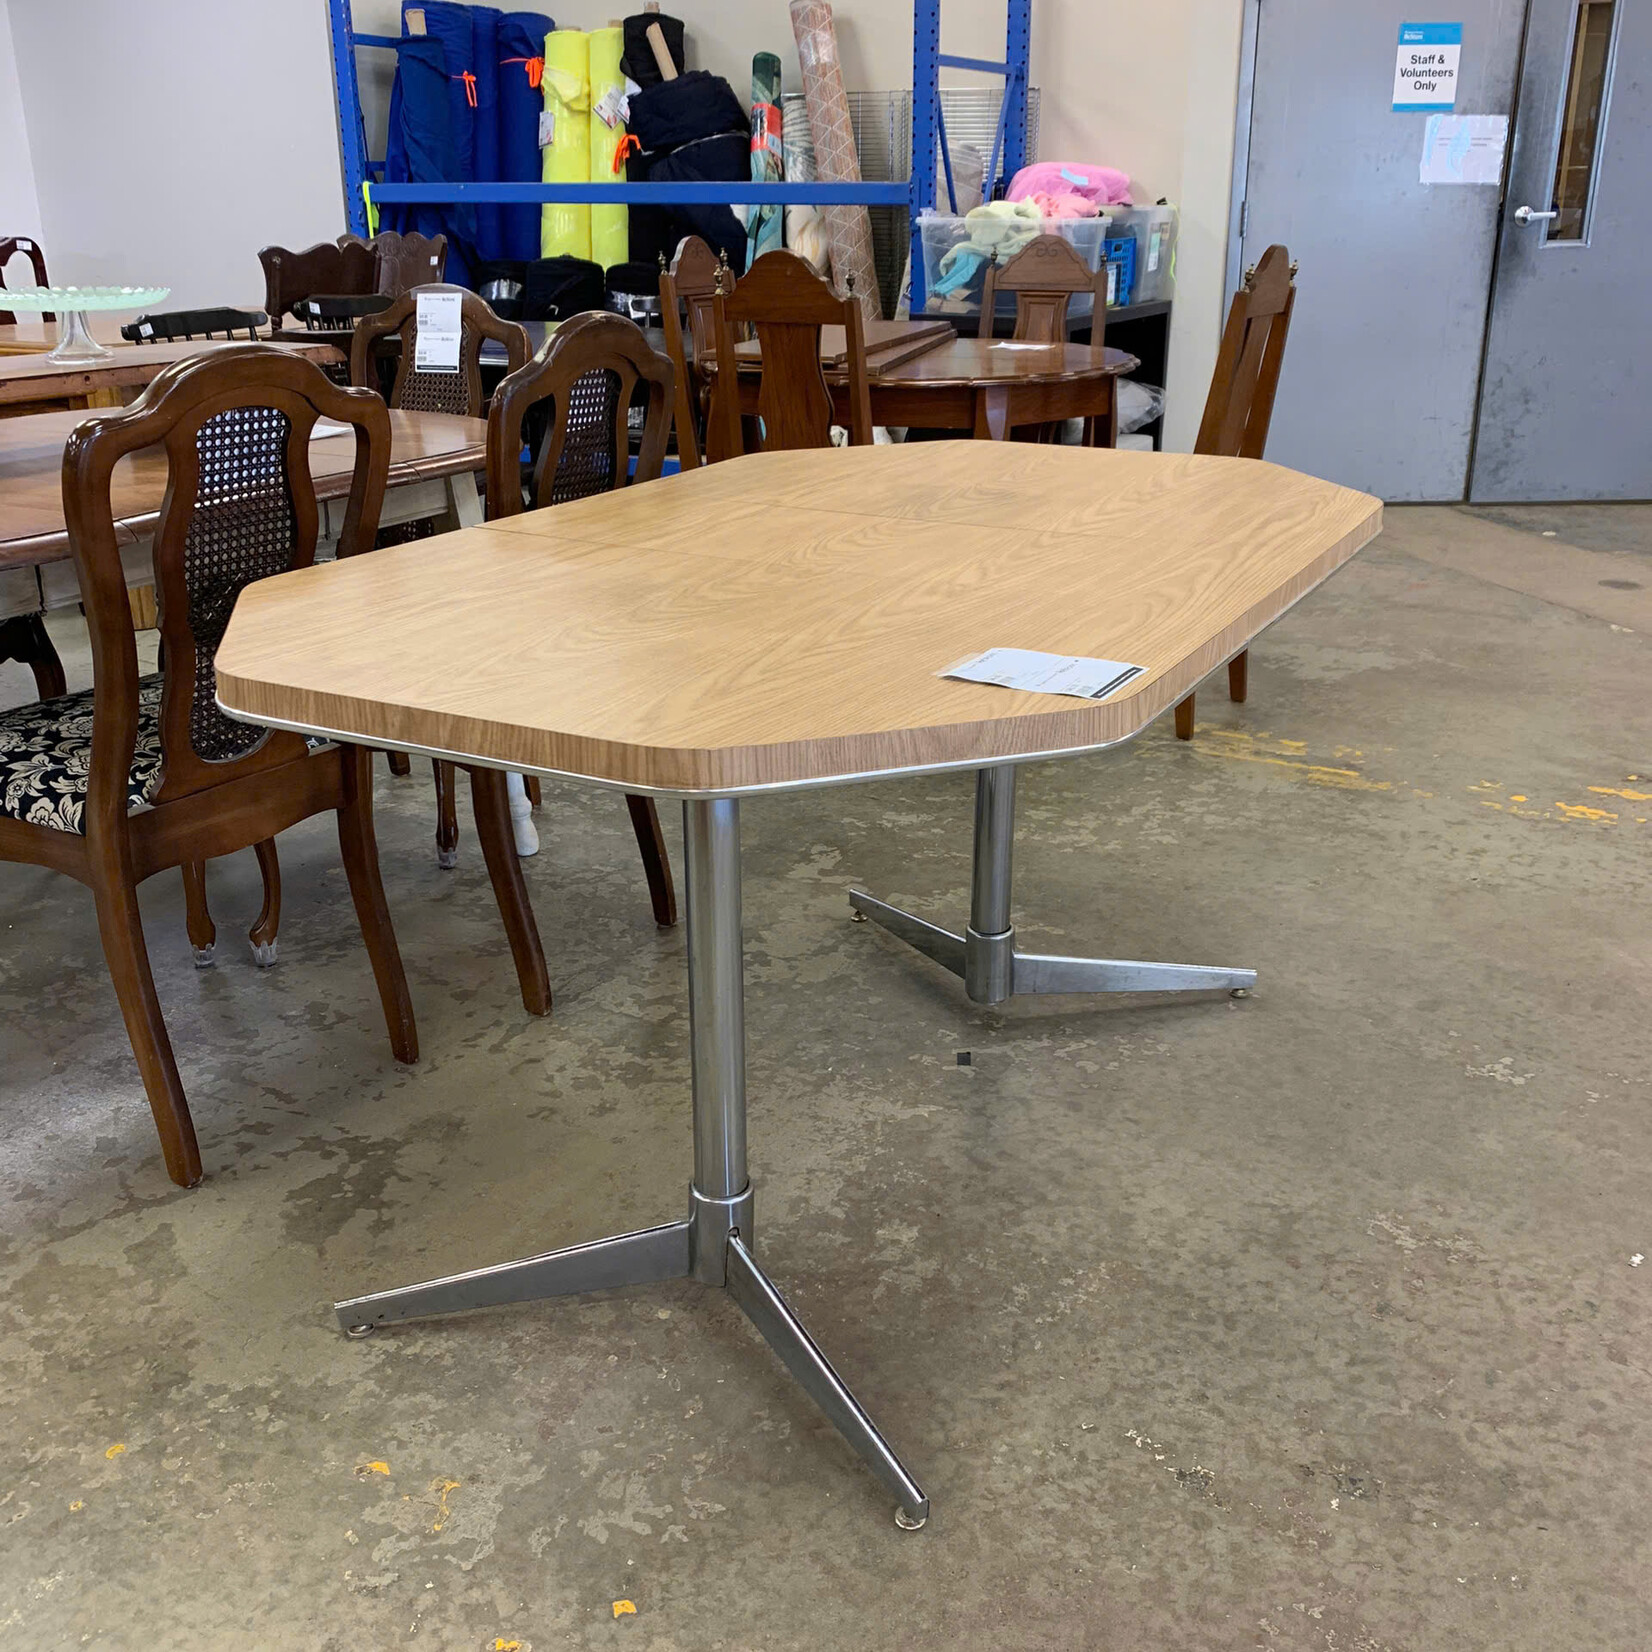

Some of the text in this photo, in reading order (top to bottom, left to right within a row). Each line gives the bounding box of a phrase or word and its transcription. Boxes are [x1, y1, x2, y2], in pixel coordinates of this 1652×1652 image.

[1410, 54, 1446, 65] Staff &
[1400, 67, 1454, 78] Volunteers
[1413, 80, 1437, 92] Only
